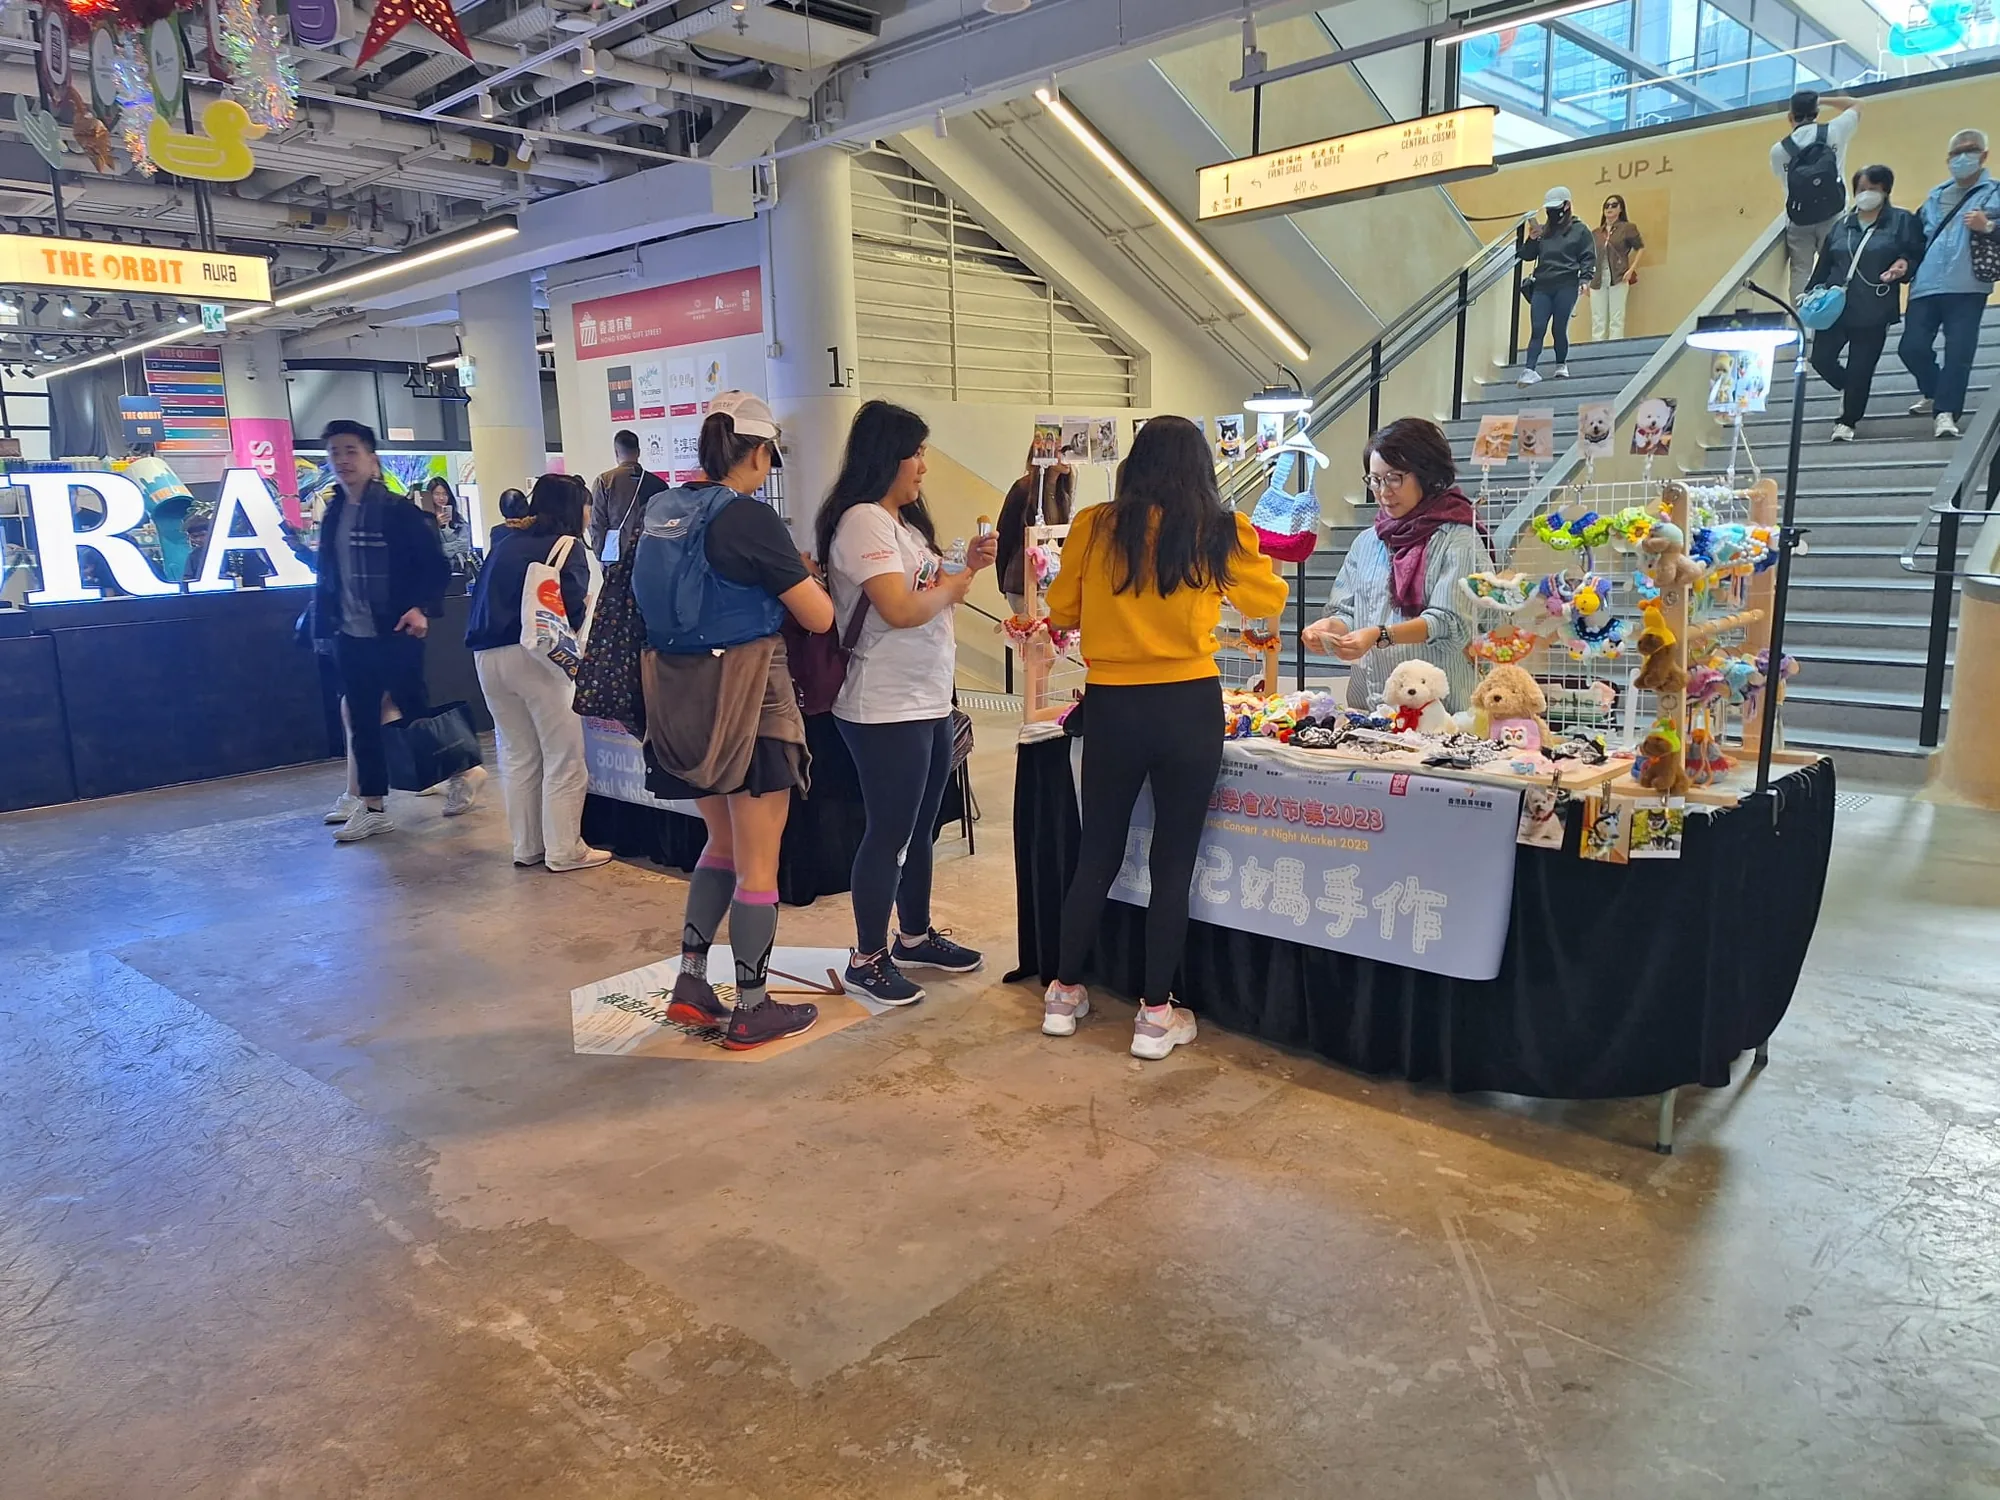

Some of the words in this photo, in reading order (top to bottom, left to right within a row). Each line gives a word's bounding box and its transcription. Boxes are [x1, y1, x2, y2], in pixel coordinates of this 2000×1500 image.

[1401, 134, 1429, 149] CENTRAL
[1432, 130, 1456, 143] COSMO
[1268, 167, 1284, 179] EVENT
[1286, 164, 1303, 178] SPACE
[1595, 166, 1611, 185] 上
[1618, 160, 1649, 180] UP
[1655, 156, 1673, 175] 上
[1223, 173, 1230, 194] 1
[42, 249, 96, 277] THE
[103, 254, 183, 284] ORBIT
[600, 335, 616, 344] HONG
[616, 332, 631, 342] KONG
[645, 328, 661, 336] STREET
[1223, 819, 1258, 836] Concert
[1271, 828, 1297, 843] Night
[1300, 834, 1337, 847] Market
[1340, 838, 1369, 851] 2023
